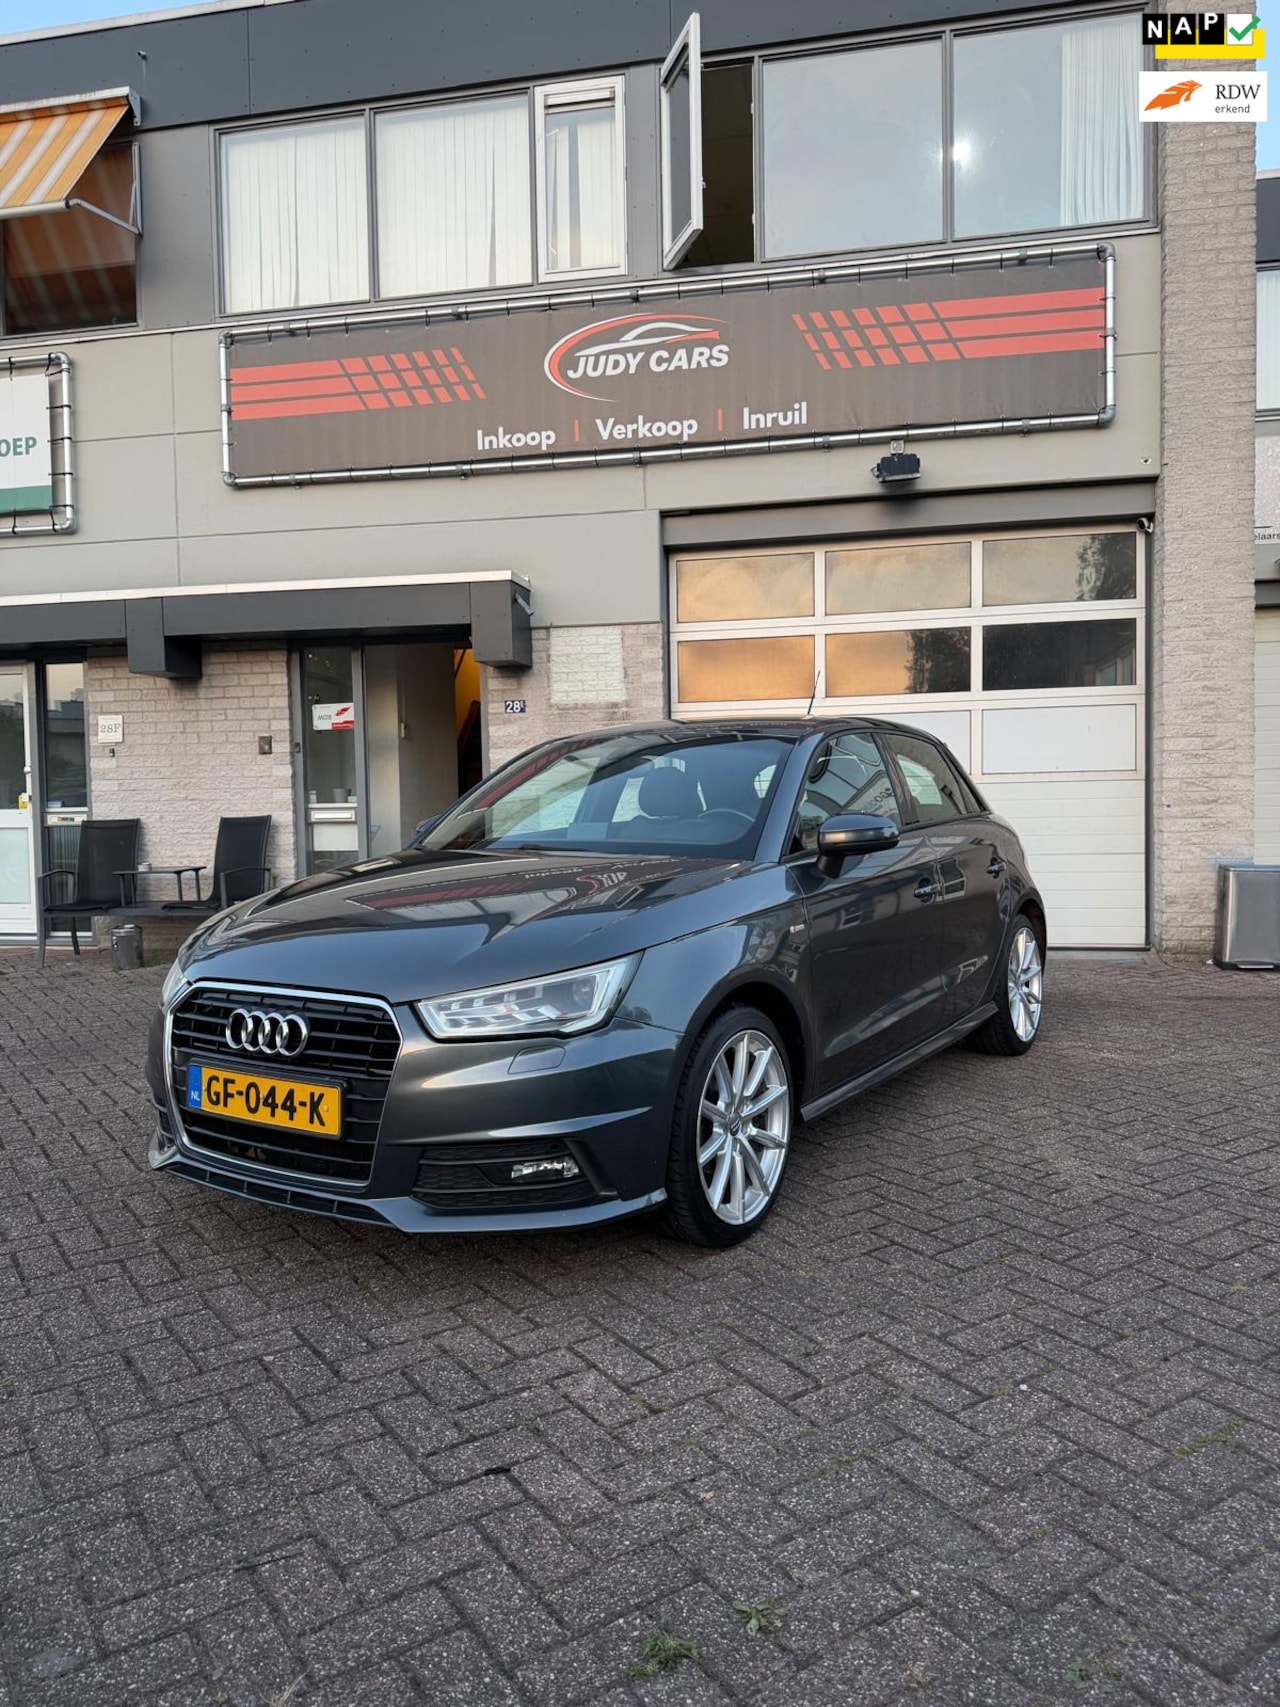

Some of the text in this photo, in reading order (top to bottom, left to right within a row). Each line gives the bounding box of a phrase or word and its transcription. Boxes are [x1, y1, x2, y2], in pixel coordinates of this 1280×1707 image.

[567, 344, 730, 380] JUDY CARS
[477, 401, 807, 451] Inkoop Verkoop Inruil
[100, 723, 121, 734] 28F
[190, 1075, 326, 1127] NL GF-044-K
